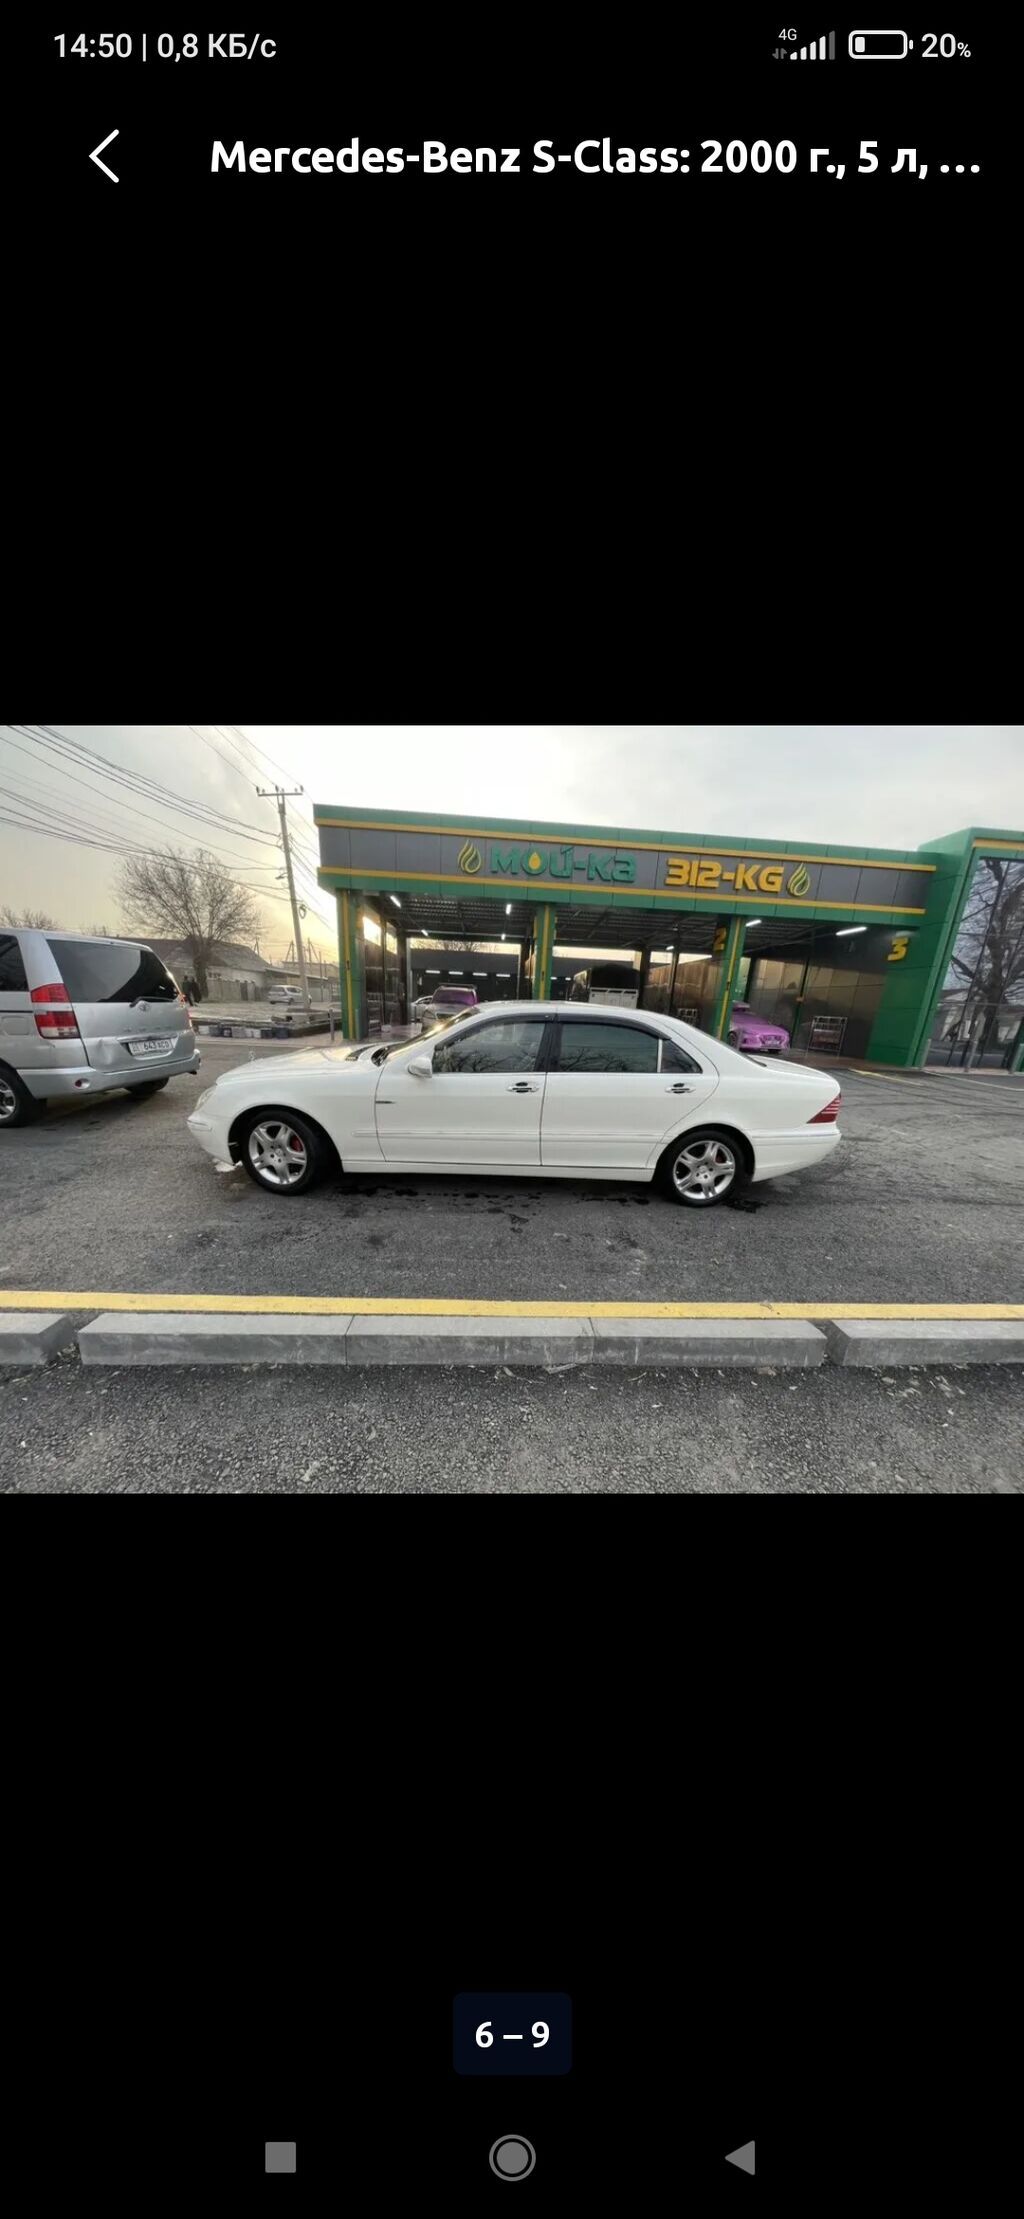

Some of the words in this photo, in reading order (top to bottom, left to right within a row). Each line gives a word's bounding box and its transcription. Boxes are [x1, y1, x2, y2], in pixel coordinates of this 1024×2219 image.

[664, 858, 785, 893] 312-KG
[713, 927, 727, 951] 2
[887, 937, 910, 962] 3
